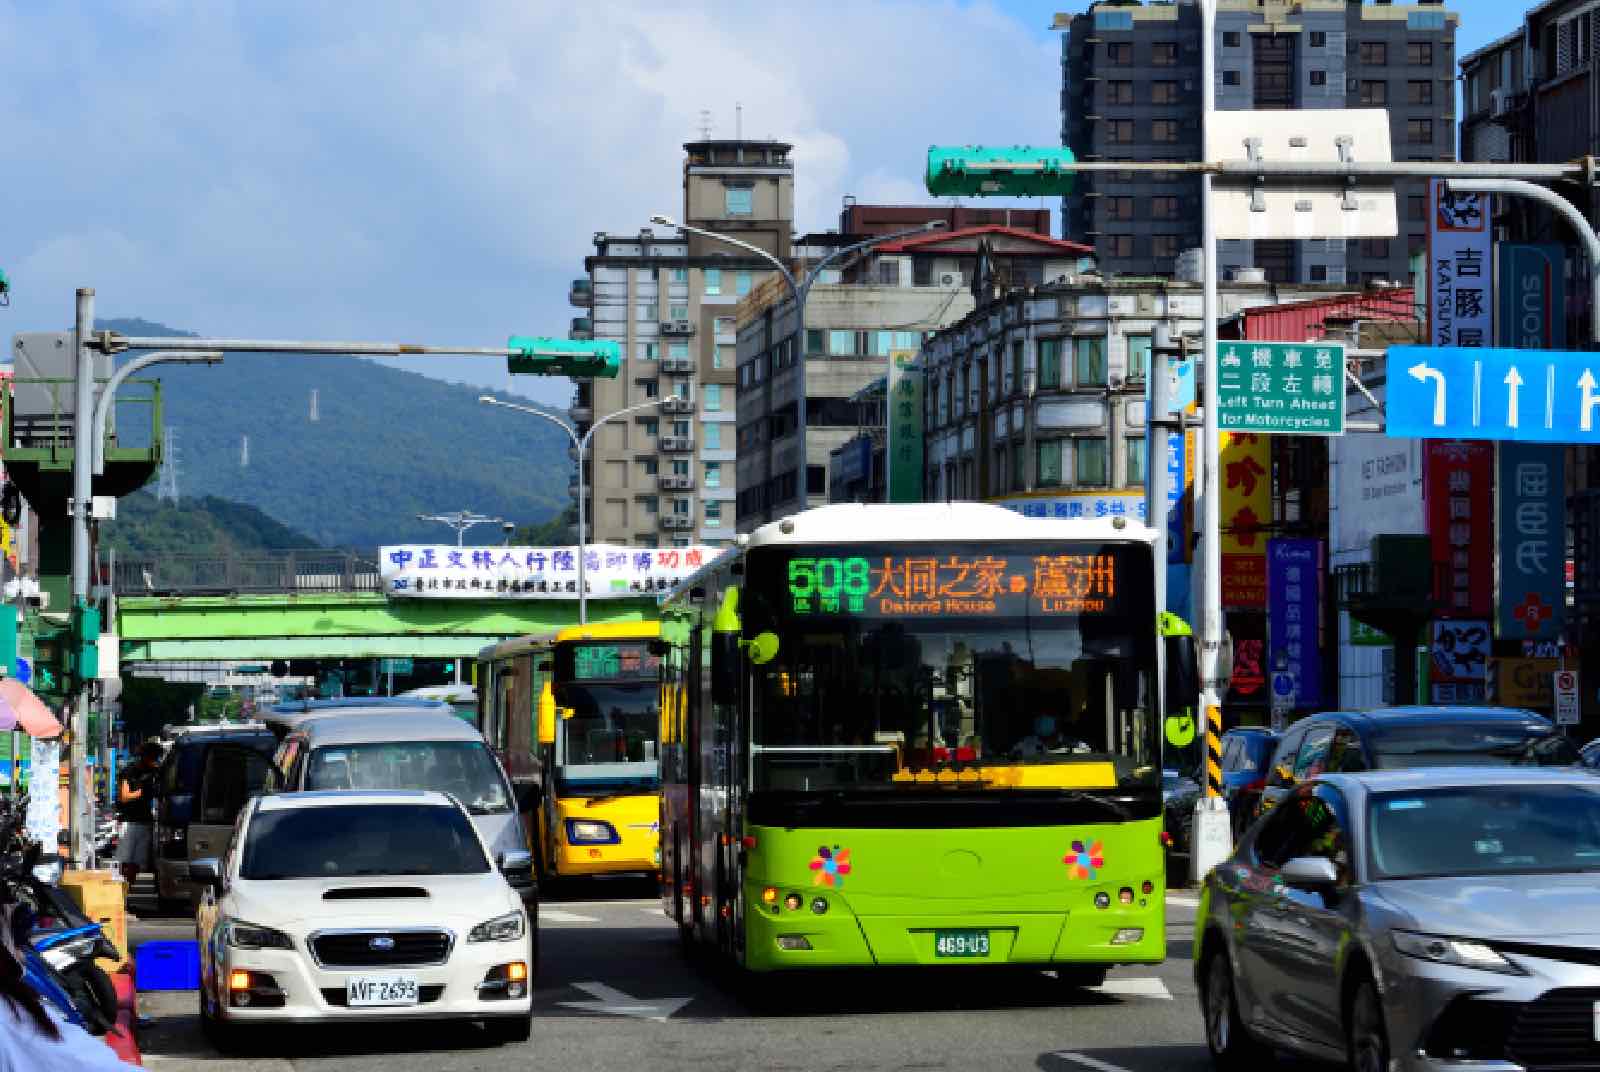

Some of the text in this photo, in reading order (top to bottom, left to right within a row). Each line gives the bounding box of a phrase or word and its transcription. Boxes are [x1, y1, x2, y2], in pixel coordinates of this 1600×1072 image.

[1220, 372, 1335, 395] 二段左轉
[1217, 396, 1336, 410] Left Turn Ahead
[1222, 413, 1330, 428] for Motorcycles
[789, 557, 871, 593] 508
[870, 556, 1116, 600] 大同之家 蘆洲
[944, 598, 996, 613] House
